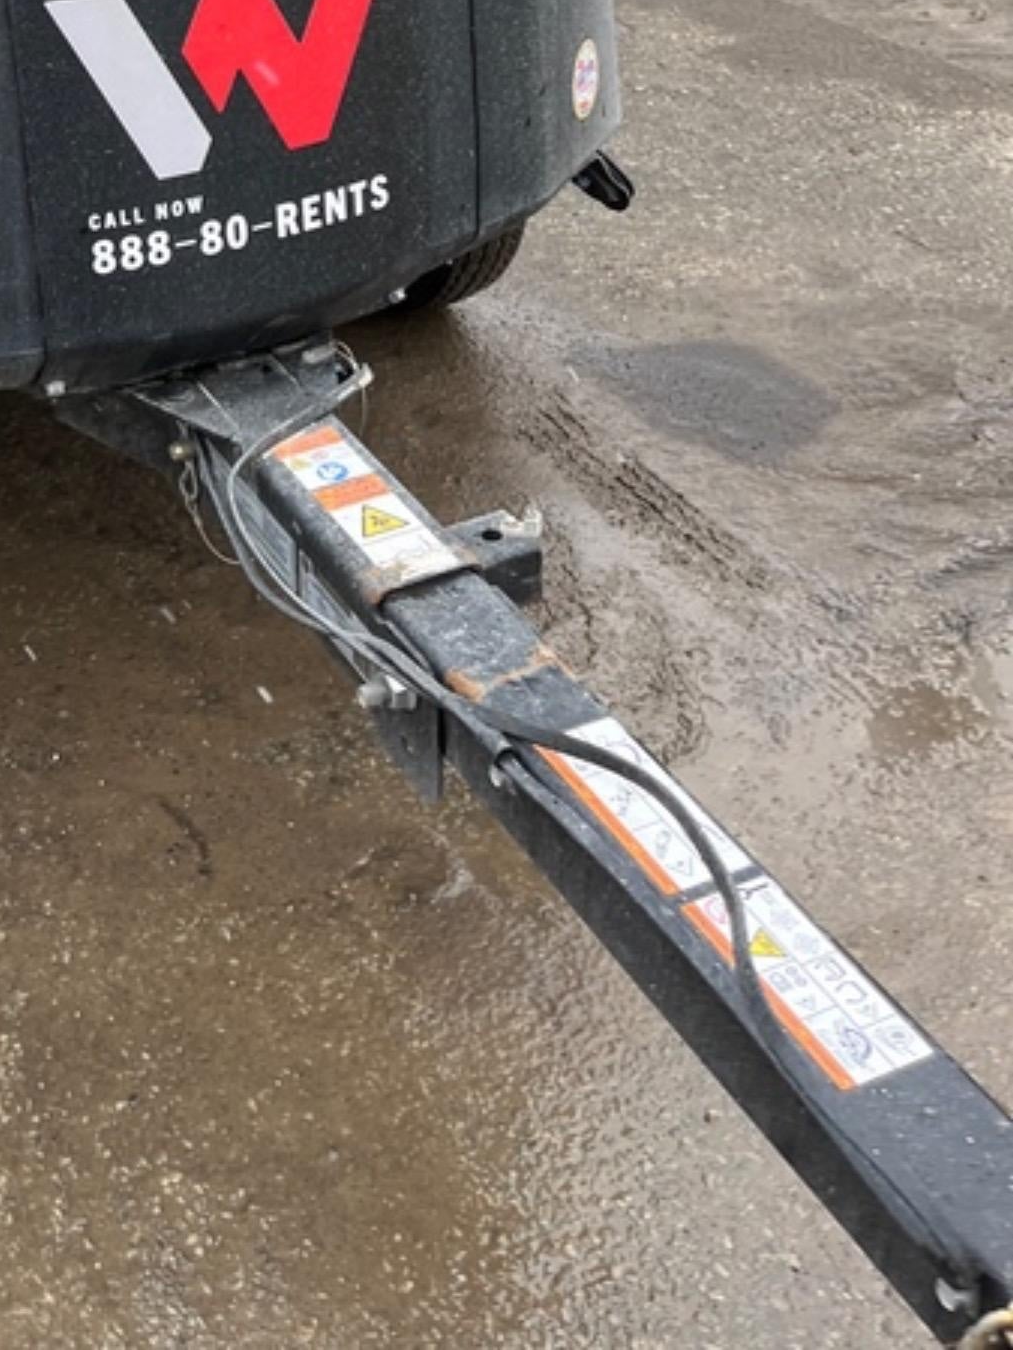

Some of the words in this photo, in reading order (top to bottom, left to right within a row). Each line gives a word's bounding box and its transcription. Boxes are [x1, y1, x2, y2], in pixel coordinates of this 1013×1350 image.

[88, 206, 145, 231] CALL
[154, 196, 204, 221] NOW
[91, 173, 389, 275] 888-80-RENTS
